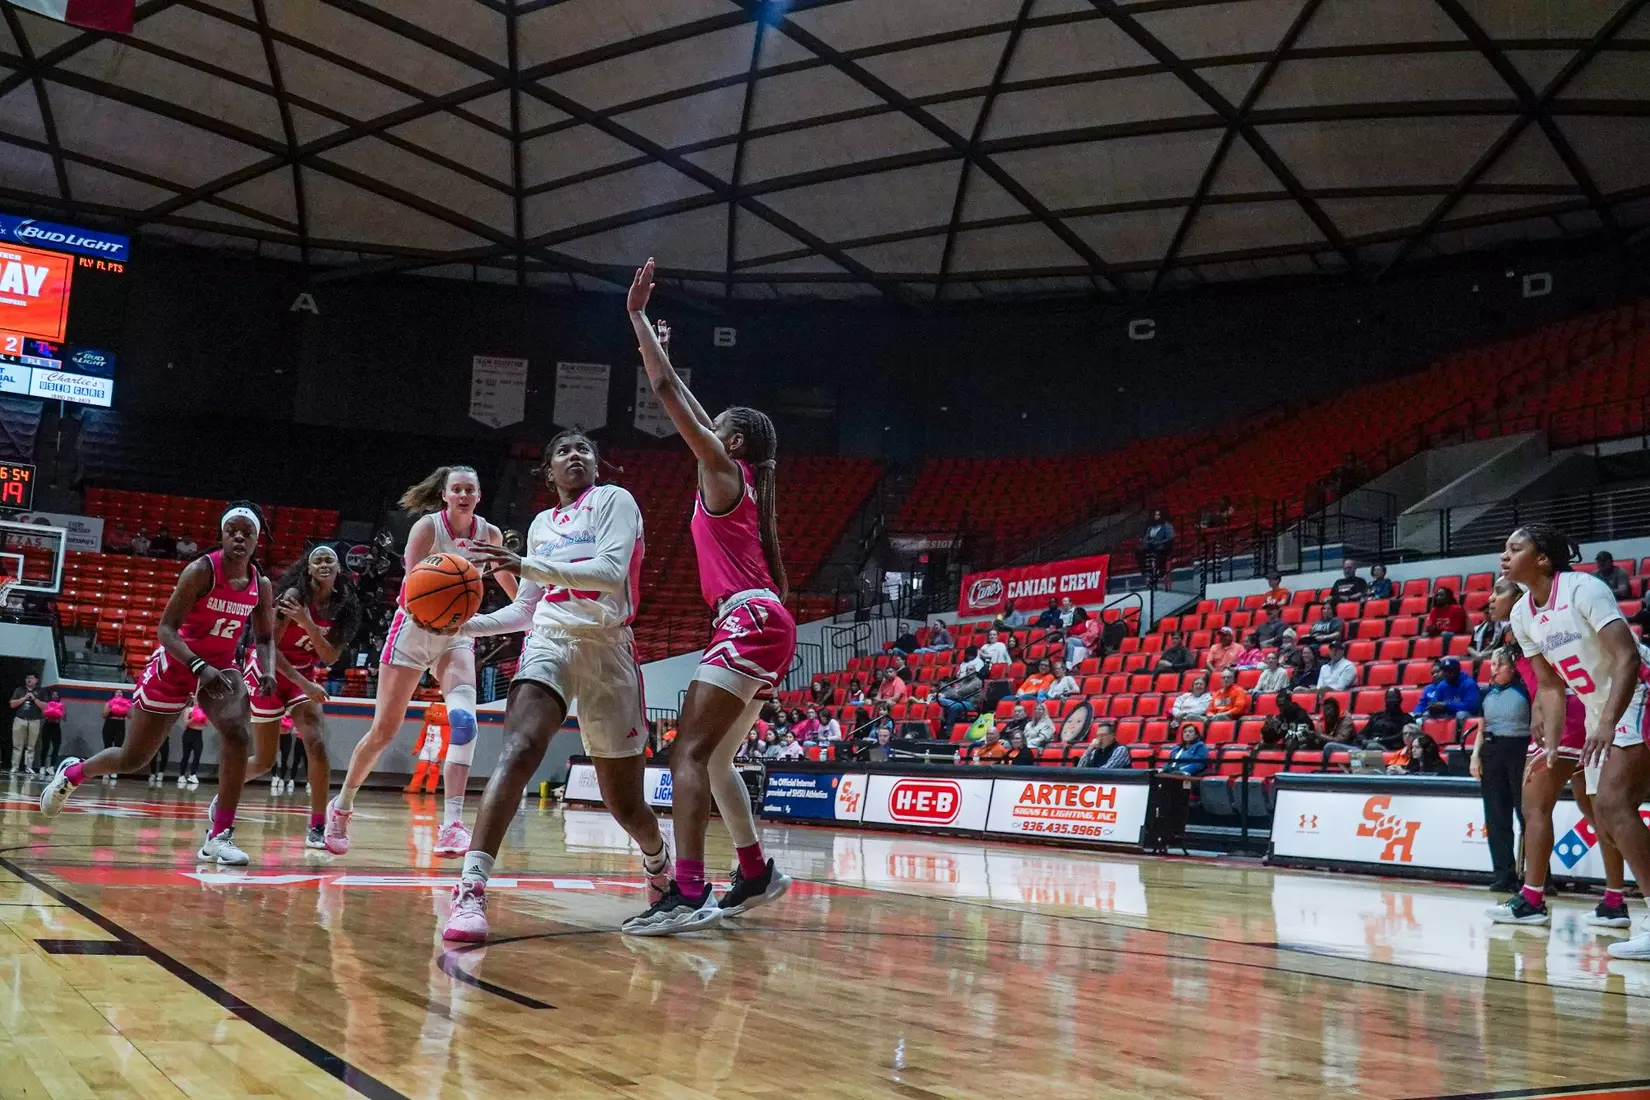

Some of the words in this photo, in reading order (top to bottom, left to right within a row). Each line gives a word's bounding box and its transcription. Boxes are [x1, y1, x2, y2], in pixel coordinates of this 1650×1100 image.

[22, 226, 65, 243] BUD
[65, 234, 123, 253] LIGHT
[107, 262, 124, 273] PTS
[1522, 273, 1552, 298] D
[290, 293, 321, 315] A
[713, 327, 738, 346] B
[1128, 318, 1156, 340] C
[5, 337, 18, 352] 2
[47, 372, 98, 388] Charlie's
[40, 381, 71, 393] USED
[73, 386, 105, 398] CARS
[2, 481, 23, 504] 19
[1007, 576, 1057, 599] CANIAC
[1060, 571, 1101, 593] CREW
[206, 597, 226, 612] SAM
[209, 617, 242, 639] 12
[660, 773, 672, 787] BU
[768, 777, 778, 786] The
[778, 777, 796, 787] Official
[796, 779, 816, 788] Internet
[766, 788, 787, 798] provider
[786, 788, 793, 797] of
[805, 790, 828, 799] Athletics
[1018, 783, 1117, 809] ARTECH
[1014, 807, 1041, 816] SIGNS
[1041, 809, 1048, 817] &
[1050, 809, 1096, 820] LIGHTING,
[1097, 813, 1116, 821] INC.
[1021, 821, 1102, 837] 936.435.9966
